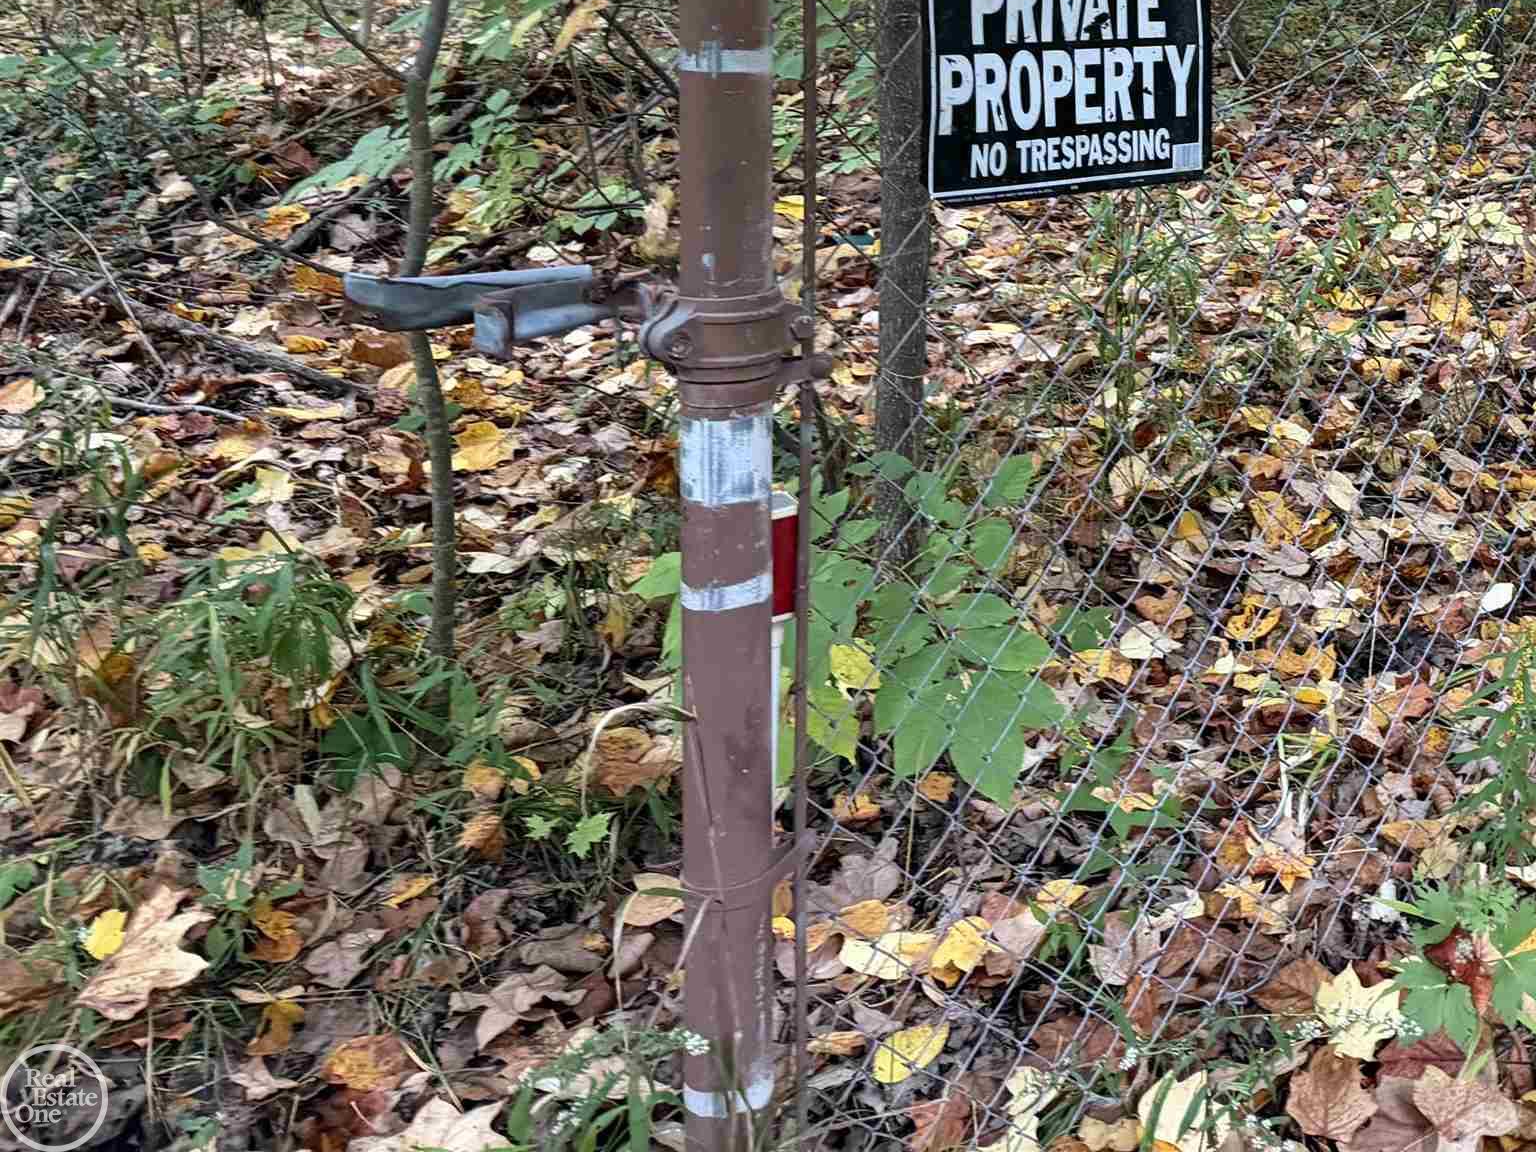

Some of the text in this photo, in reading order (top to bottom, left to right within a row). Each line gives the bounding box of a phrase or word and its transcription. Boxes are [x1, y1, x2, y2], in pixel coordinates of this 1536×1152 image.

[938, 44, 1196, 136] PROPERTY
[970, 128, 1171, 178] NO TRESPASSING
